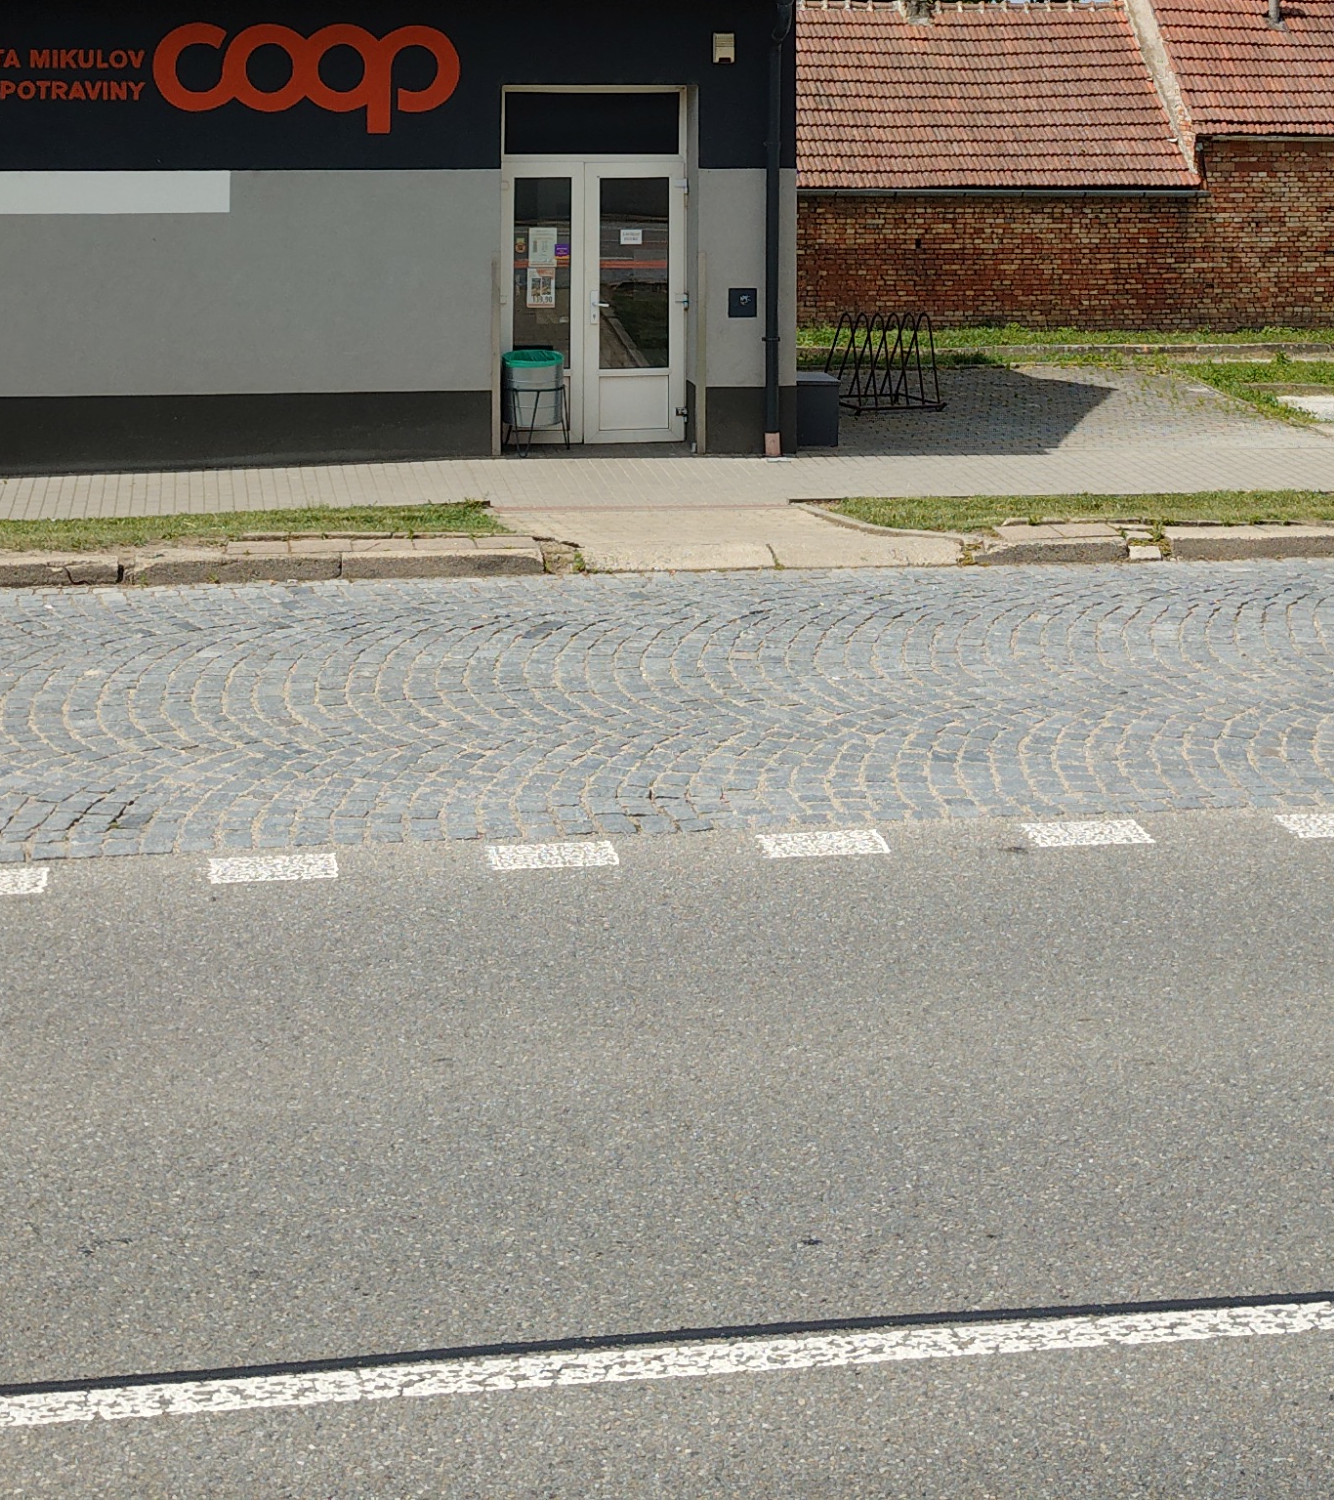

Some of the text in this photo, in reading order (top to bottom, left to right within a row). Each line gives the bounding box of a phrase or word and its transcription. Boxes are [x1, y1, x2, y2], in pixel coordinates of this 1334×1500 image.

[29, 48, 145, 69] MIKULOV
[152, 23, 460, 134] coop
[0, 80, 145, 100] POTRAVINY
